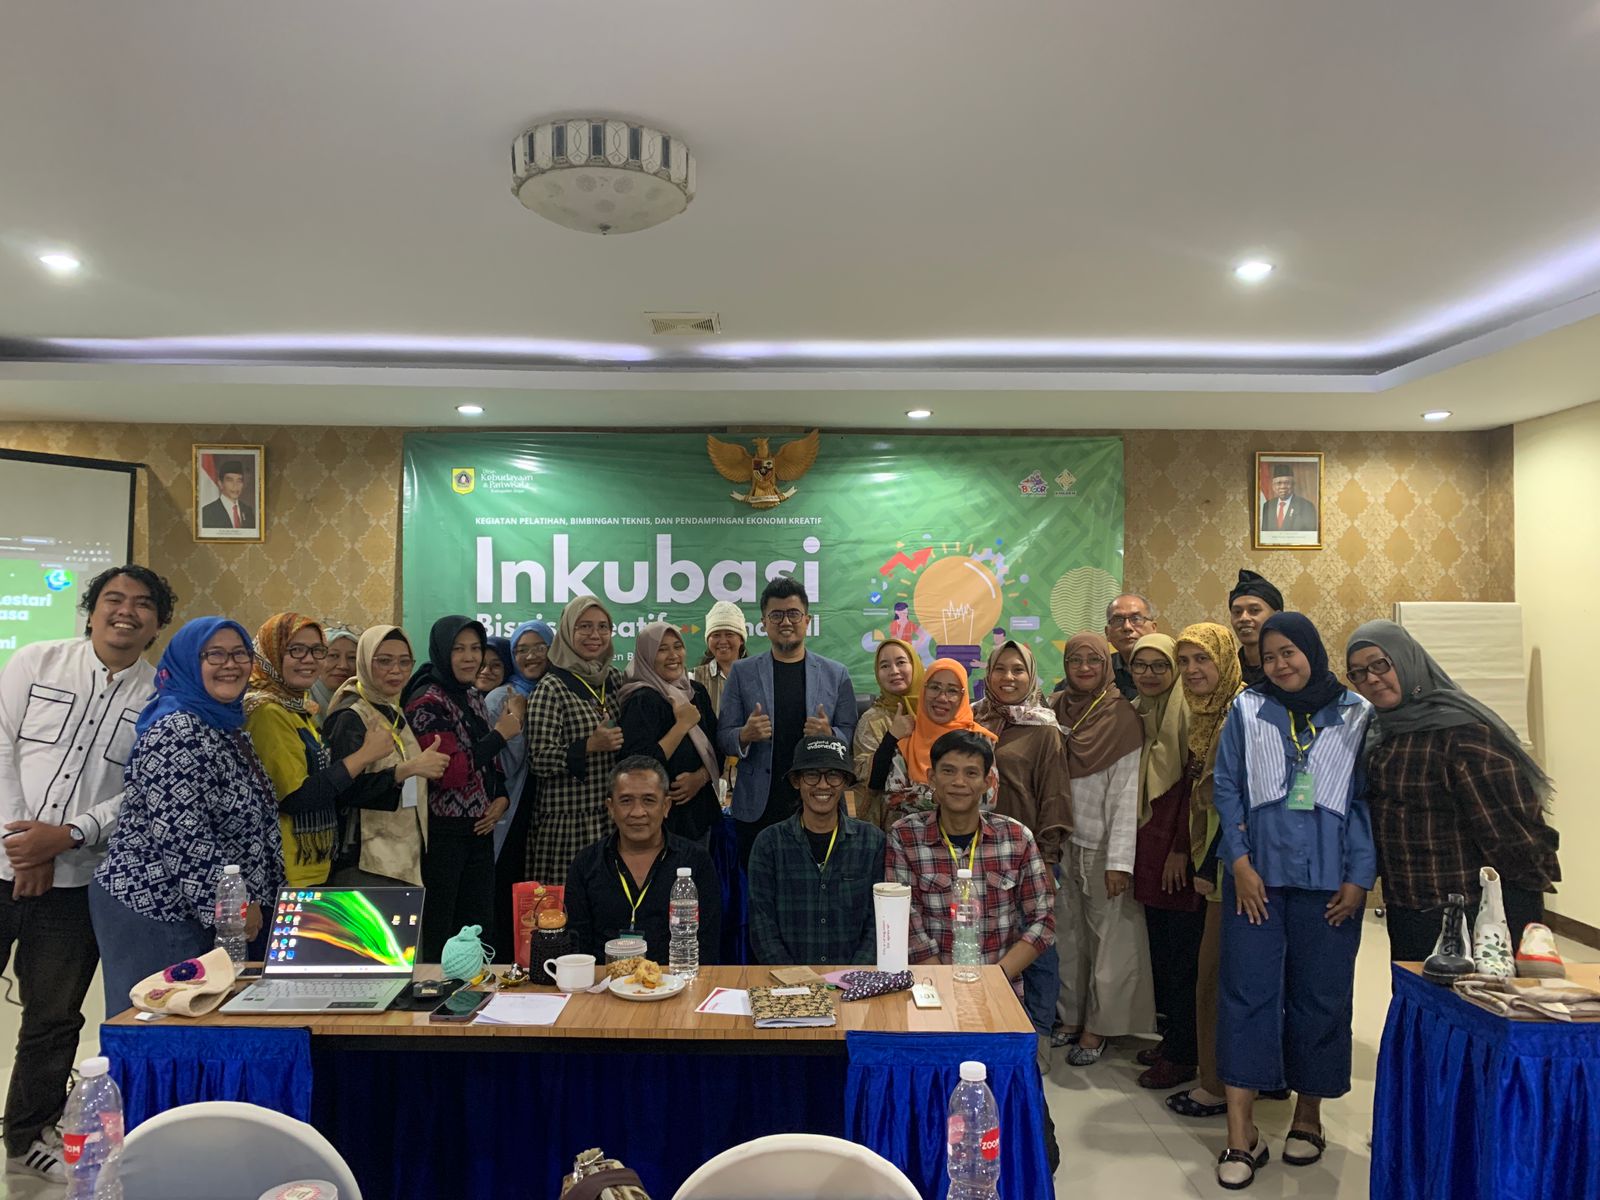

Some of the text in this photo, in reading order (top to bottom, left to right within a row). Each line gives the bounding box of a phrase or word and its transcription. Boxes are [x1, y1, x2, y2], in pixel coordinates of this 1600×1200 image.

[475, 516, 823, 526] KEGIATAN PELATIHAN, BIMBINGAN TEKNIS, DAN PENDAMPINGAN EKONOMI KREATIF
[476, 533, 821, 604] Inkubasi
